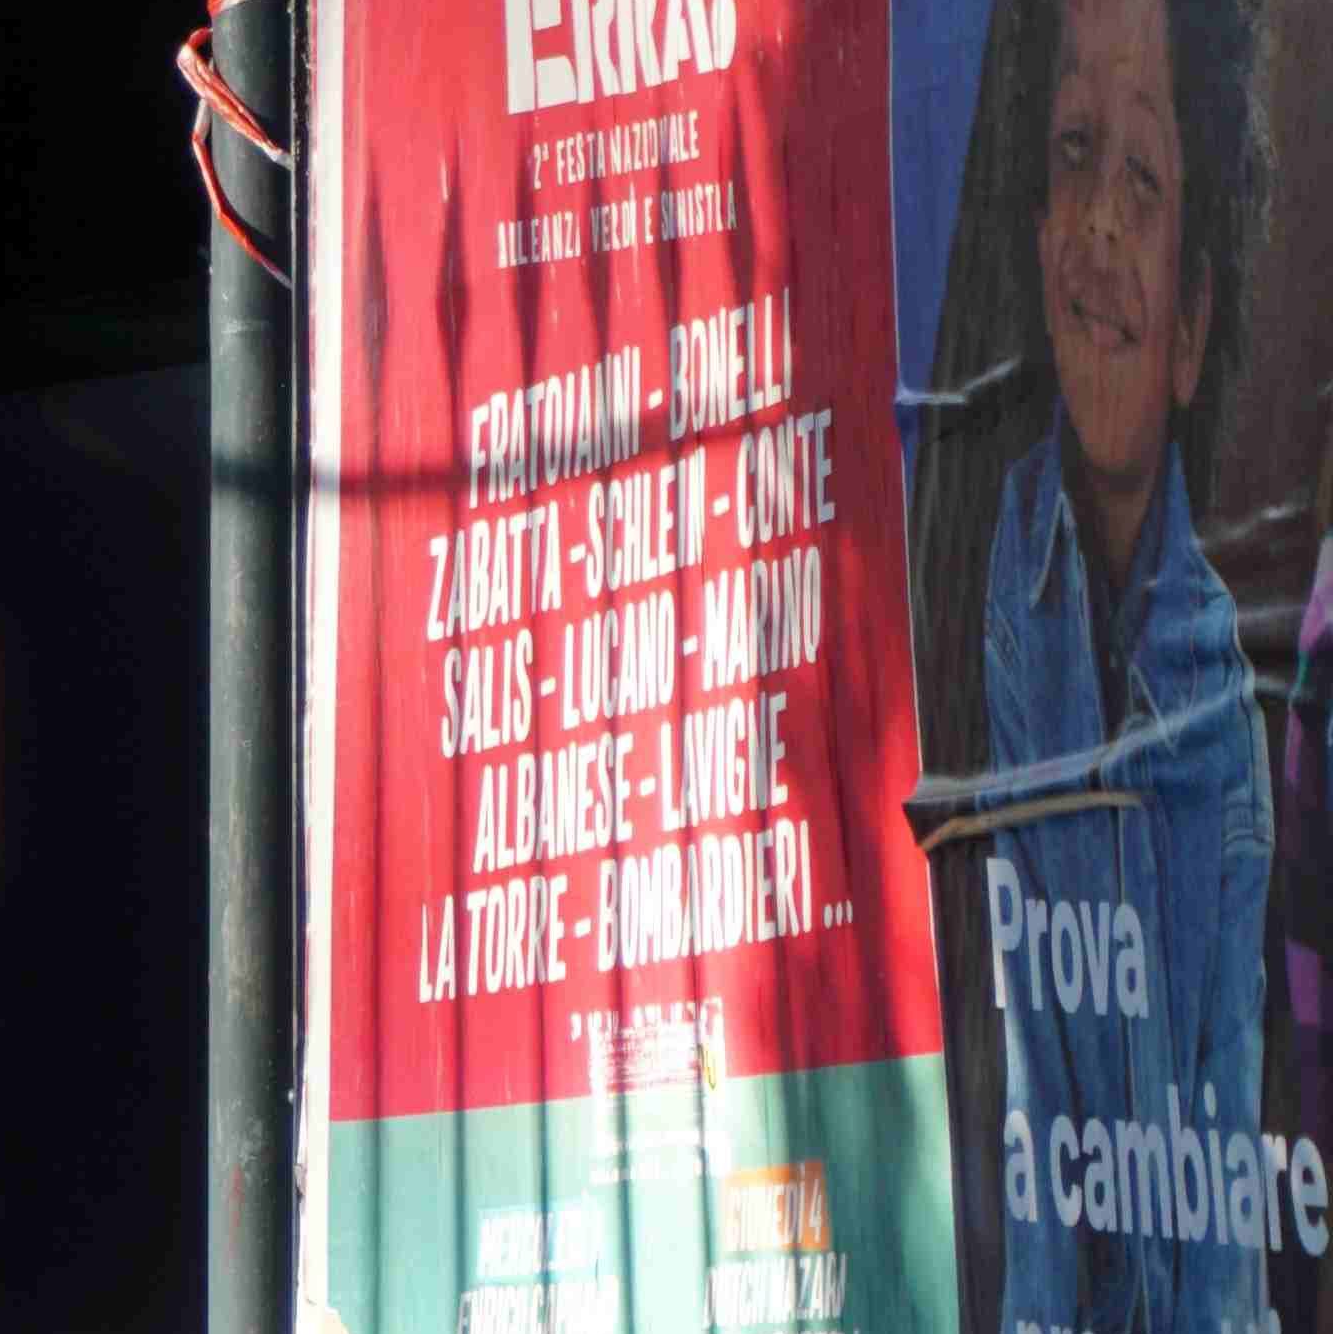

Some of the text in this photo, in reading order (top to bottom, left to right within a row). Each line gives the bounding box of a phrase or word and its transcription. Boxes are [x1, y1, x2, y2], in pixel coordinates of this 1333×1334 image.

[556, 130, 606, 185] FESTA
[609, 110, 700, 175] NAZIONALE
[644, 197, 653, 244] E
[469, 345, 641, 509] FRATOIANNI
[669, 287, 792, 442] BONELLI
[427, 501, 562, 641] ZABATTA
[736, 409, 835, 549] CONTE
[442, 628, 532, 758] SALIS
[562, 591, 675, 730] LUCANO
[702, 546, 821, 692] MARINO
[472, 731, 633, 874] ALBANESE
[660, 691, 788, 832] LAVIGNE
[419, 894, 455, 1003] LA
[466, 874, 568, 996] TORRE
[597, 818, 812, 972] BOMBARDIERI
[986, 858, 1149, 1019] Prova
[1005, 1083, 1330, 1258] a cambiare
